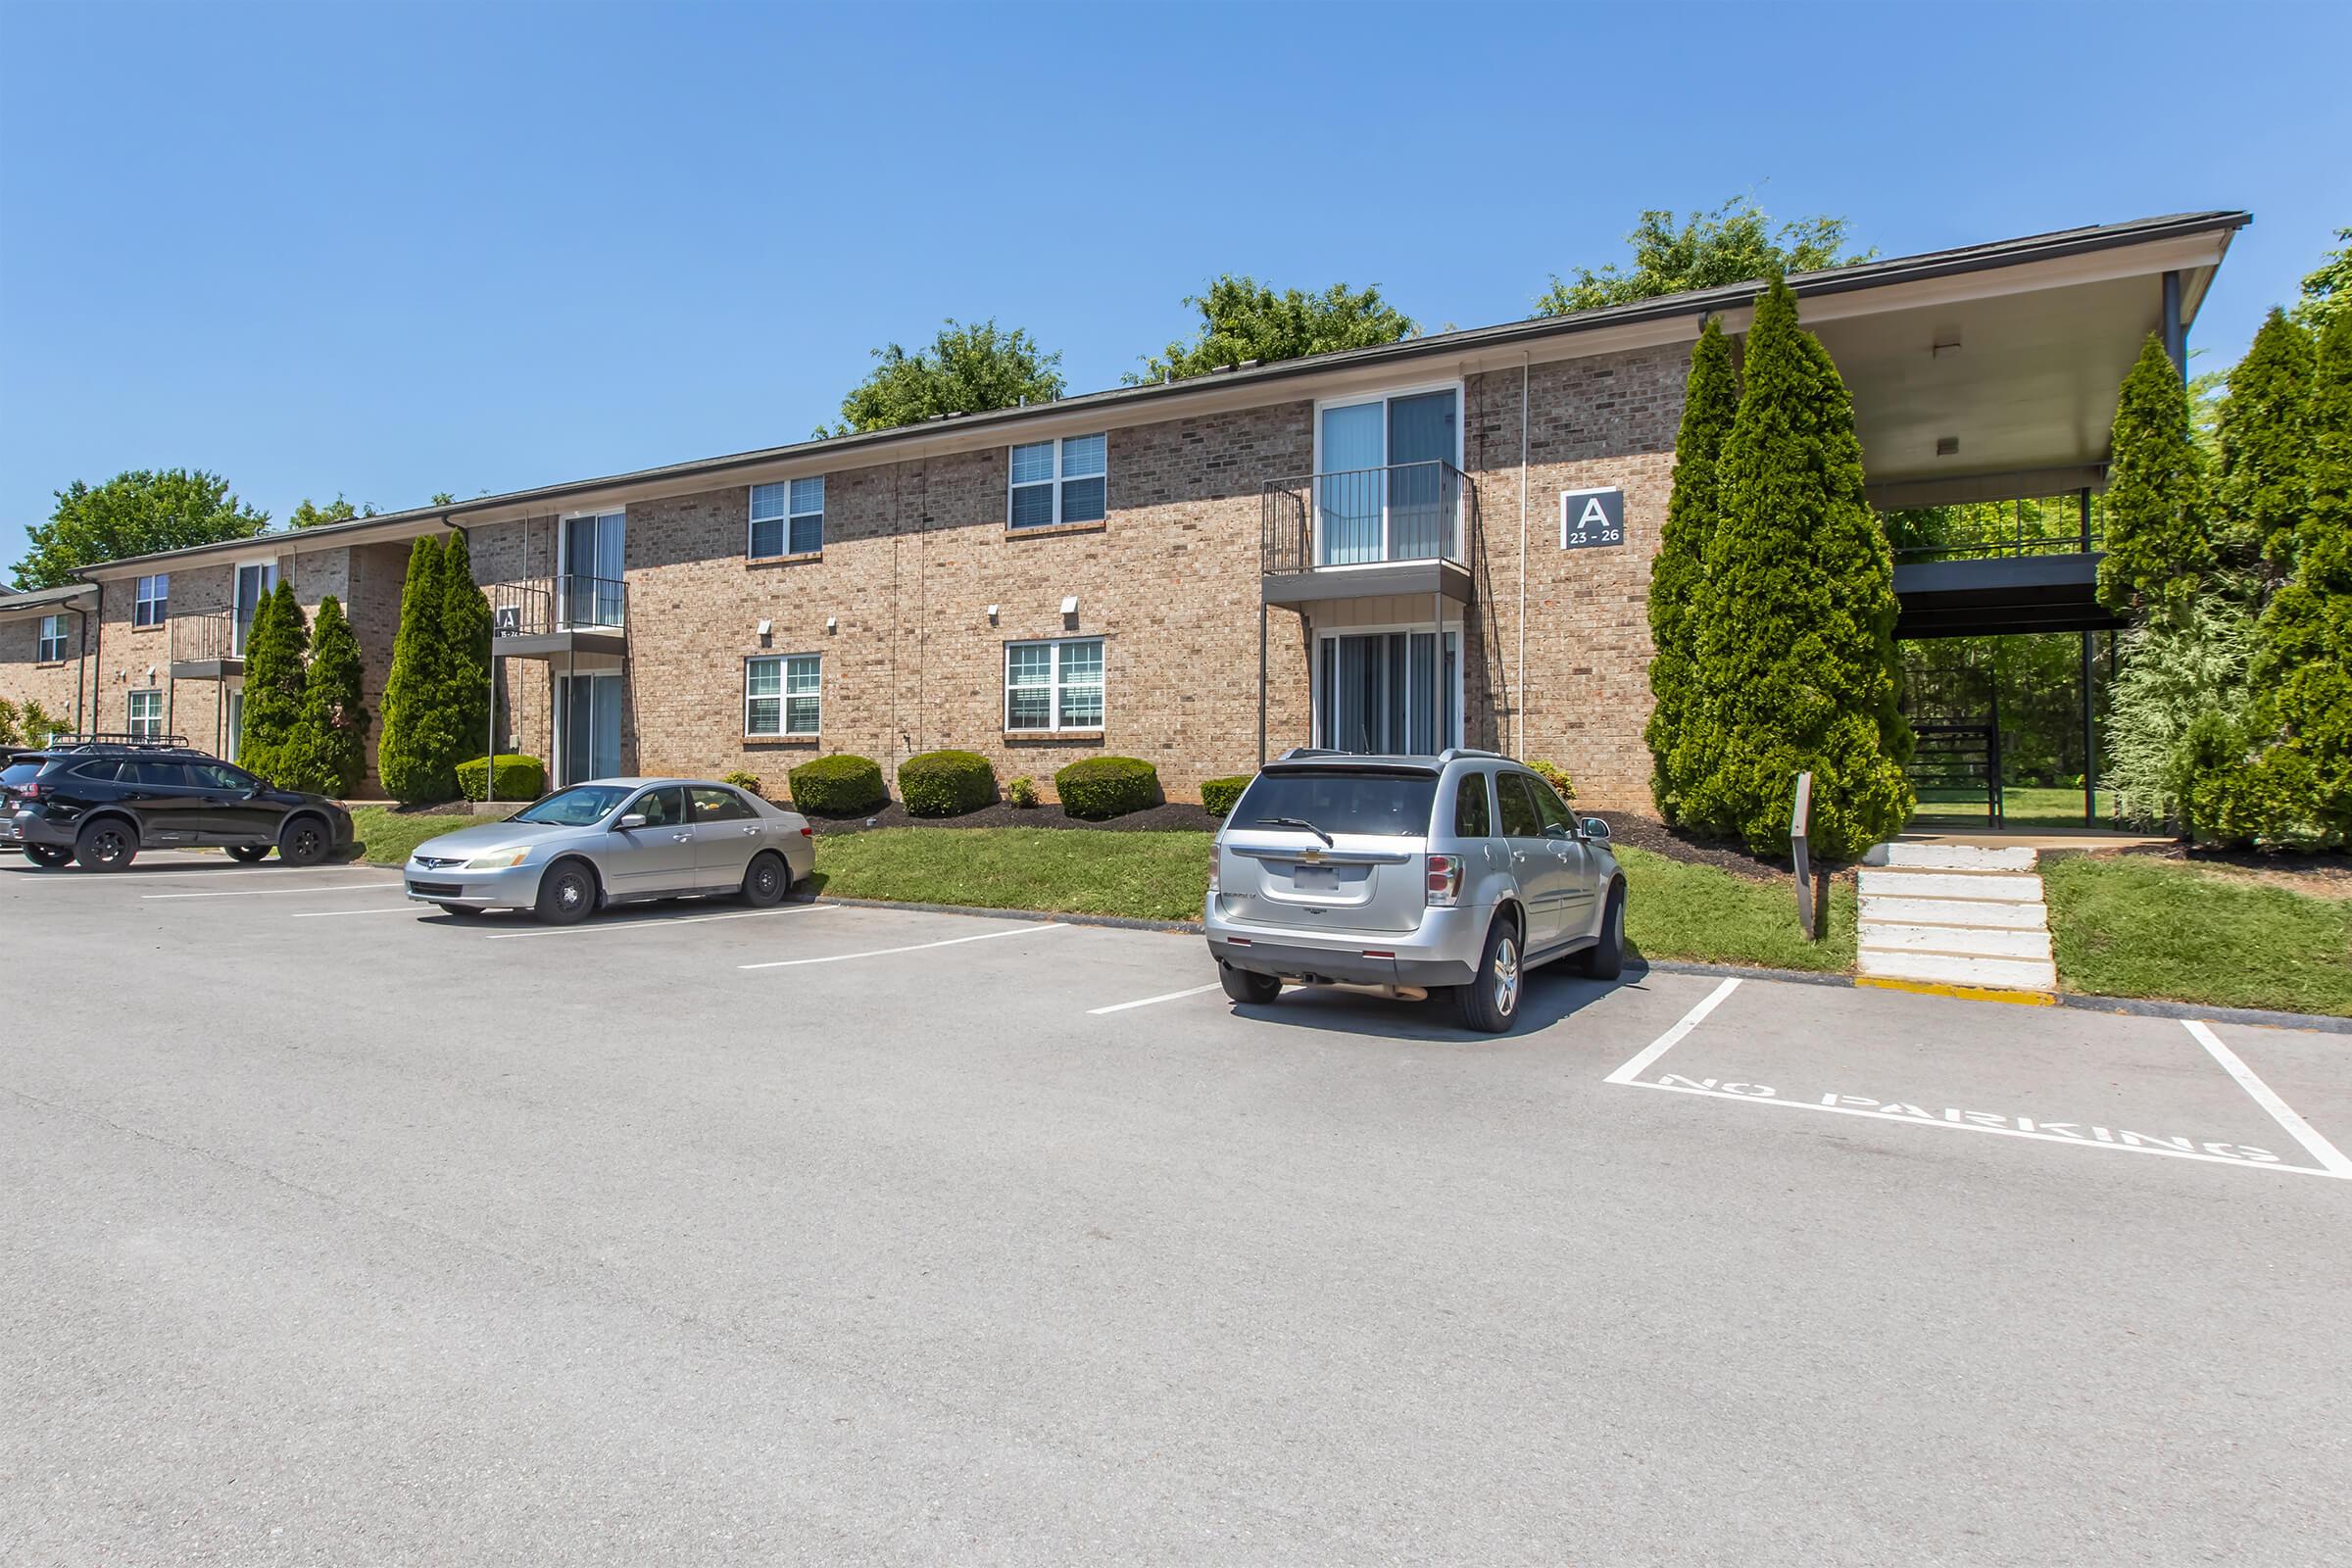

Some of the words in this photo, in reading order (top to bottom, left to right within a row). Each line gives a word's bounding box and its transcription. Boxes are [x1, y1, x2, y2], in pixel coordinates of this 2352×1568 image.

[1577, 498, 1610, 529] A
[1570, 532, 1587, 544] 23
[1601, 529, 1619, 541] 26
[503, 611, 514, 627] A
[1657, 1073, 1777, 1097] NO
[1821, 1093, 2279, 1161] PARKING
